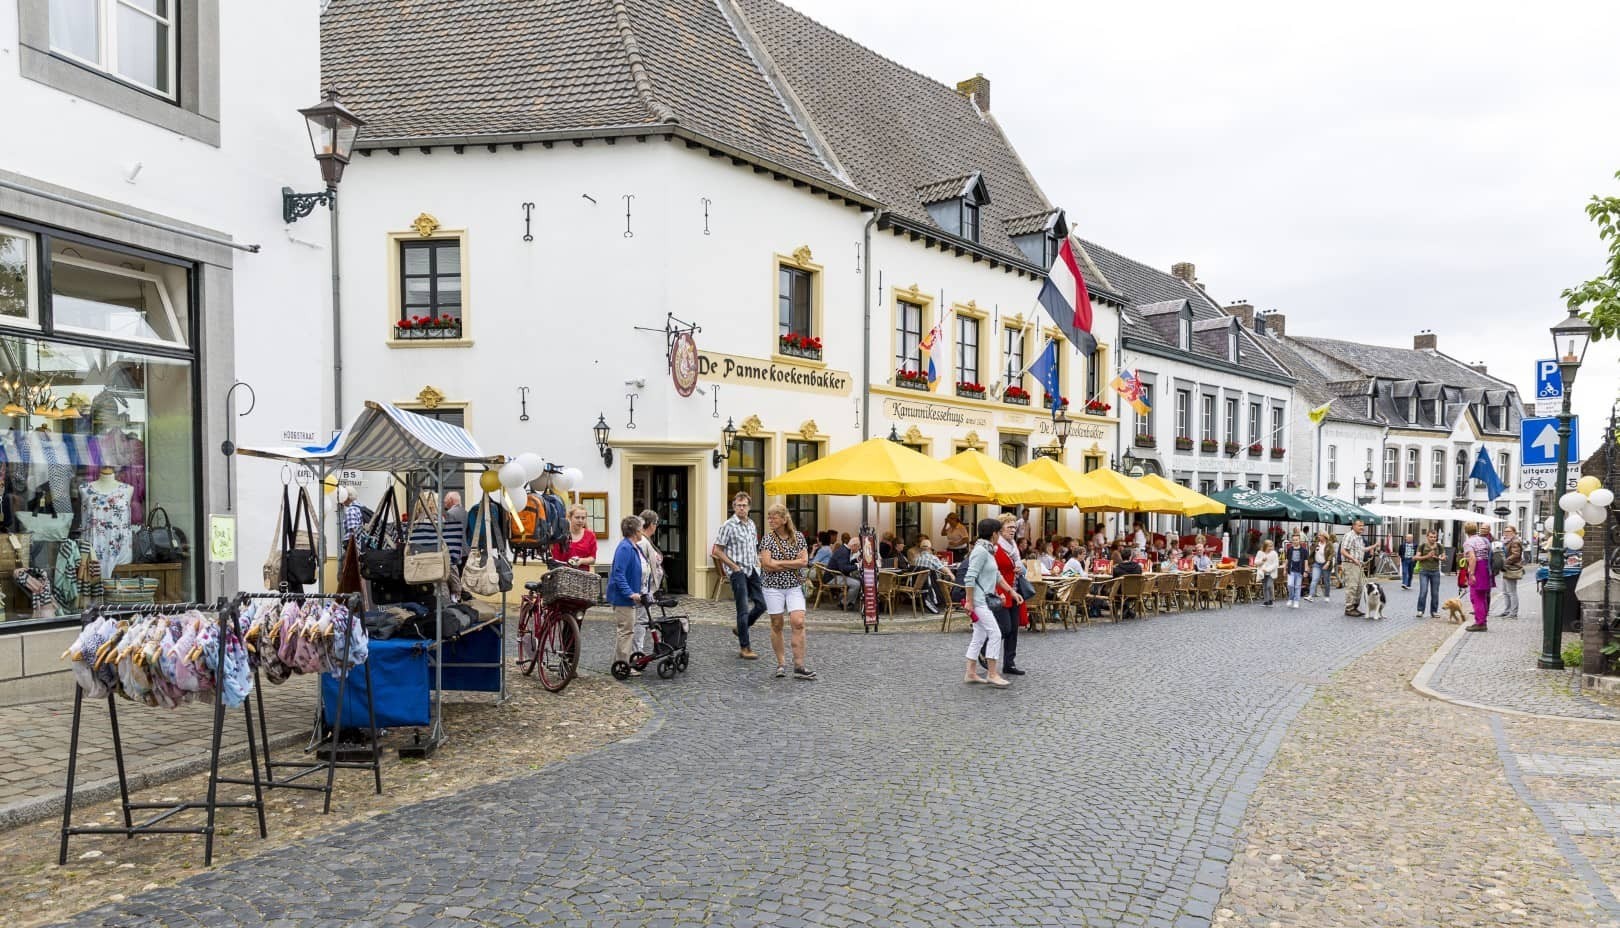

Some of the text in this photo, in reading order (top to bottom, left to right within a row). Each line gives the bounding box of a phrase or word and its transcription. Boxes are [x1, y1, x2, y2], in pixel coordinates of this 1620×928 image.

[697, 355, 718, 375] De
[723, 358, 846, 390] Pannekoekenbakker
[1541, 361, 1558, 382] P
[1522, 466, 1579, 476] uitgezord
